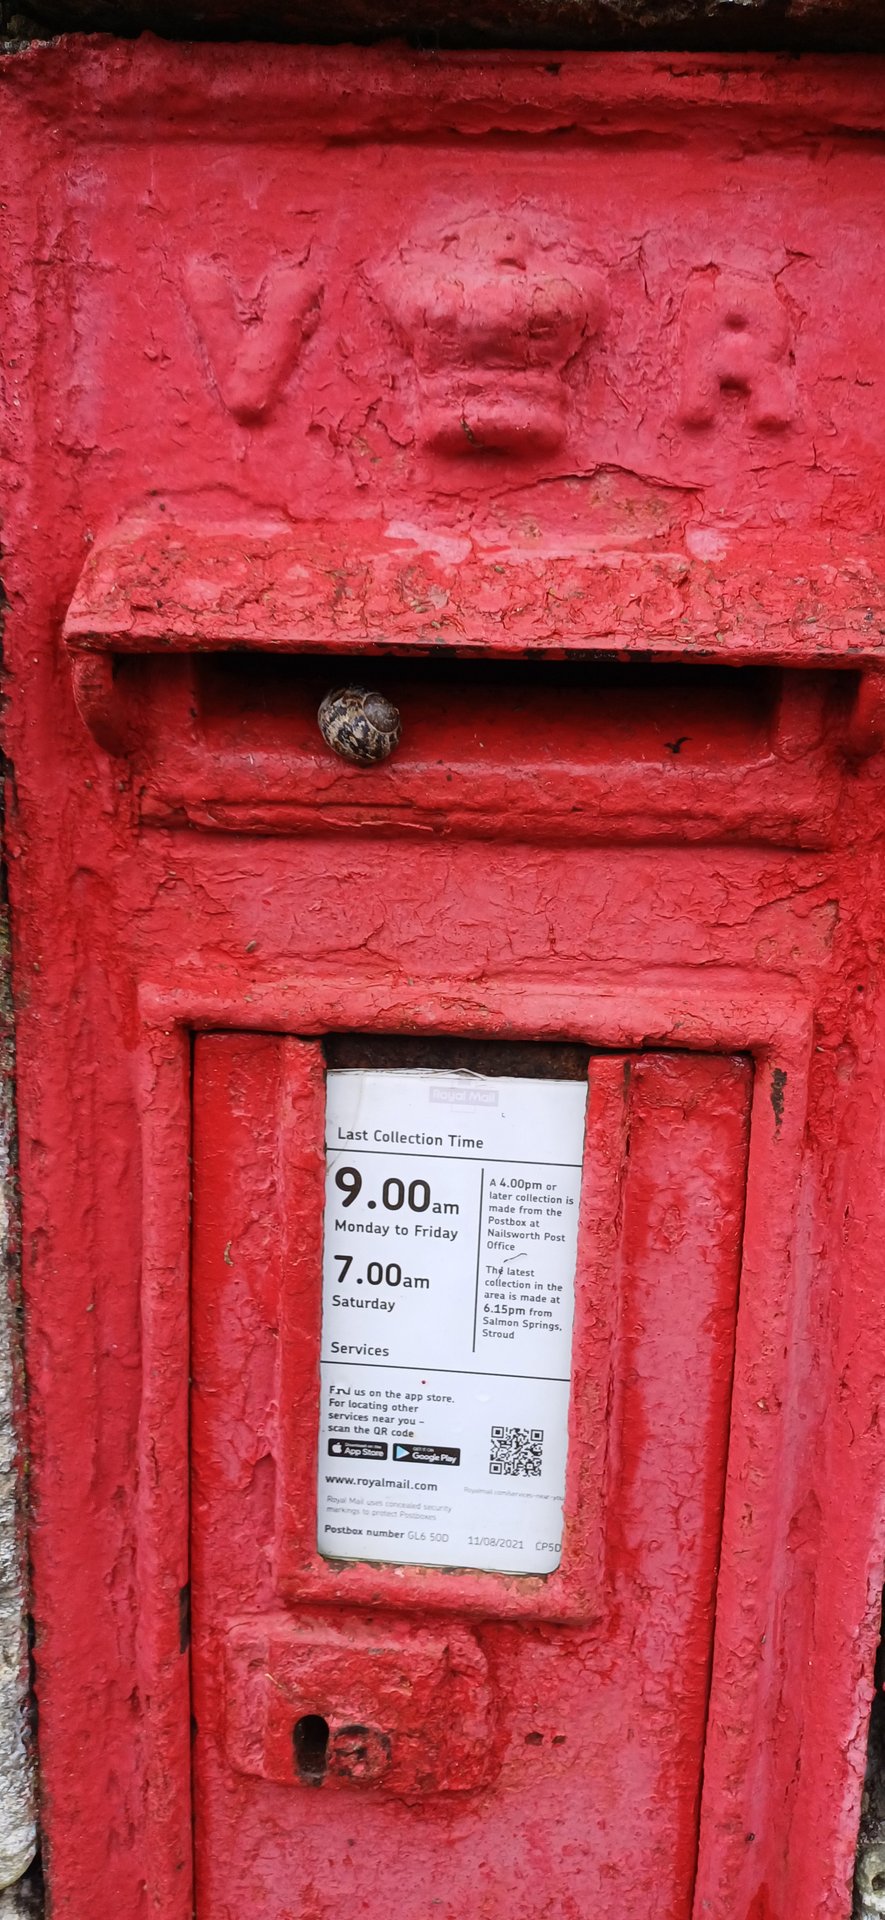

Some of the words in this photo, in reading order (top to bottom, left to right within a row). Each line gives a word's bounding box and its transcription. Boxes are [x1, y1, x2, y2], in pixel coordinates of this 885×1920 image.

[183, 254, 324, 427] V
[676, 263, 795, 434] R
[433, 1089, 466, 1102] Royal
[468, 1090, 495, 1103] Mail
[338, 1127, 368, 1141] Last
[373, 1129, 443, 1146] Collection
[448, 1134, 484, 1149] Time
[335, 1166, 459, 1215] 9.00am
[489, 1178, 496, 1187] A
[500, 1178, 542, 1191] 4.00pm
[489, 1191, 512, 1200] later
[515, 1193, 562, 1204] collection
[566, 1196, 574, 1205] is
[489, 1205, 515, 1213] made
[519, 1206, 542, 1215] from
[546, 1208, 562, 1217] the
[488, 1216, 526, 1226] Postbox
[530, 1220, 540, 1228] at
[335, 1219, 390, 1237] Monday
[395, 1224, 409, 1235] to
[415, 1225, 458, 1241] Friday
[487, 1229, 540, 1240] Nailsworth
[544, 1232, 566, 1242] Post
[487, 1241, 515, 1251] Office
[334, 1254, 430, 1289] 7.00am
[486, 1265, 503, 1275] The
[507, 1267, 535, 1277] latest
[485, 1278, 531, 1289] collection
[534, 1281, 543, 1290] in
[547, 1283, 563, 1292] the
[332, 1295, 395, 1312] Saturday
[484, 1292, 505, 1300] area
[509, 1292, 517, 1300] is
[520, 1294, 547, 1303] made
[550, 1296, 560, 1304] at
[483, 1303, 525, 1316] 6.15pm
[529, 1308, 552, 1317] from
[483, 1316, 519, 1327] Salmon
[522, 1319, 562, 1331] Springs,
[482, 1329, 515, 1339] Stroud
[330, 1342, 389, 1357] Services
[329, 1385, 351, 1395] Fnd
[385, 1391, 402, 1399] the
[405, 1392, 423, 1401] app
[427, 1394, 455, 1403] store.
[329, 1398, 345, 1407] For
[348, 1400, 388, 1412] locating
[392, 1404, 419, 1413] other
[328, 1412, 369, 1422] services
[398, 1418, 416, 1426] you
[328, 1424, 350, 1433] scan
[354, 1426, 370, 1434] the
[373, 1427, 388, 1436] QR
[391, 1429, 414, 1438] code
[344, 1447, 361, 1456] App
[362, 1448, 384, 1457] Store
[412, 1451, 440, 1462] Google
[441, 1453, 457, 1464] Play
[325, 1475, 438, 1491] www.royalmail.com
[327, 1495, 346, 1504] Royal
[349, 1496, 364, 1505] Mail
[367, 1499, 383, 1507] uses
[423, 1503, 452, 1513] security
[326, 1506, 360, 1516] markings
[371, 1509, 397, 1518] protect
[324, 1524, 363, 1535] Postbox
[367, 1528, 405, 1539] number
[407, 1531, 426, 1541] GL6
[468, 1536, 524, 1549] 11/08/2021
